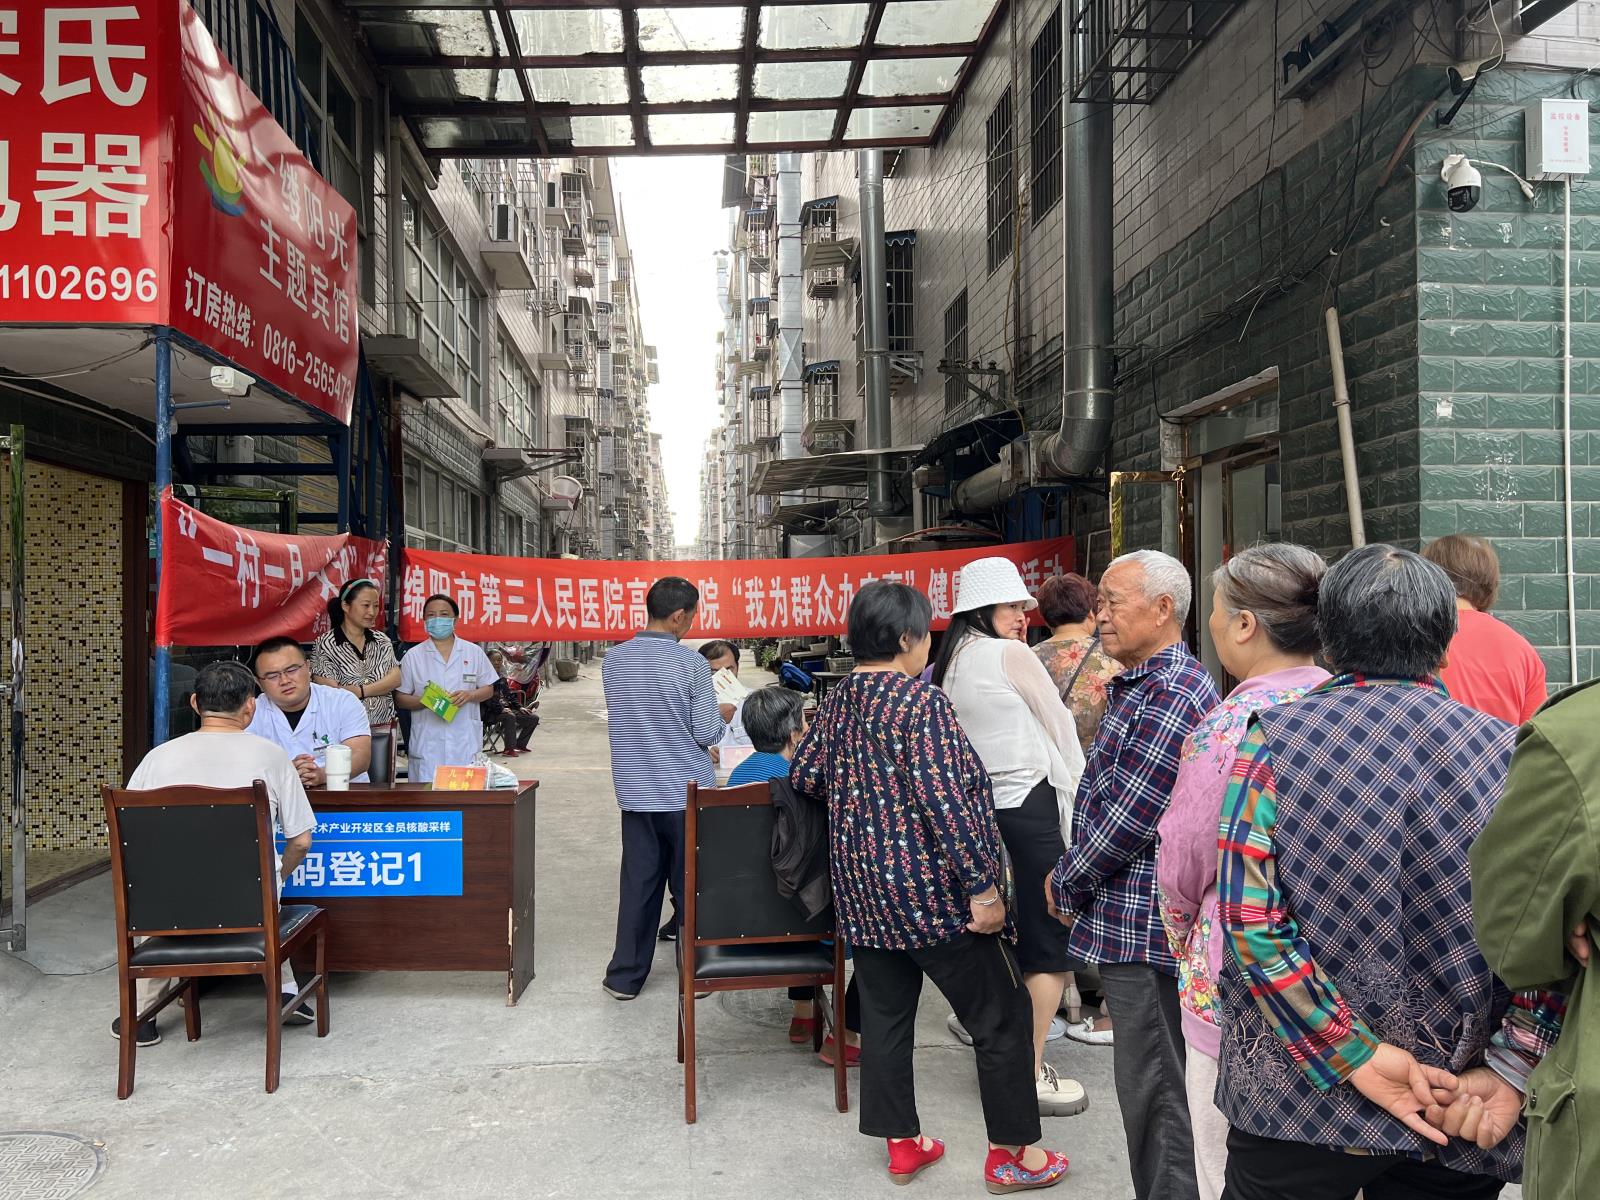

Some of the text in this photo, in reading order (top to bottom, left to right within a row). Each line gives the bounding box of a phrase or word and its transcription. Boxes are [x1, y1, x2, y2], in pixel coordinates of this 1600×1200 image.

[0, 6, 148, 107] 氏
[0, 132, 150, 239] 器
[252, 142, 350, 273] 一缕阳光
[259, 217, 350, 345] 主题宾馆
[281, 850, 422, 887] 码登记1
